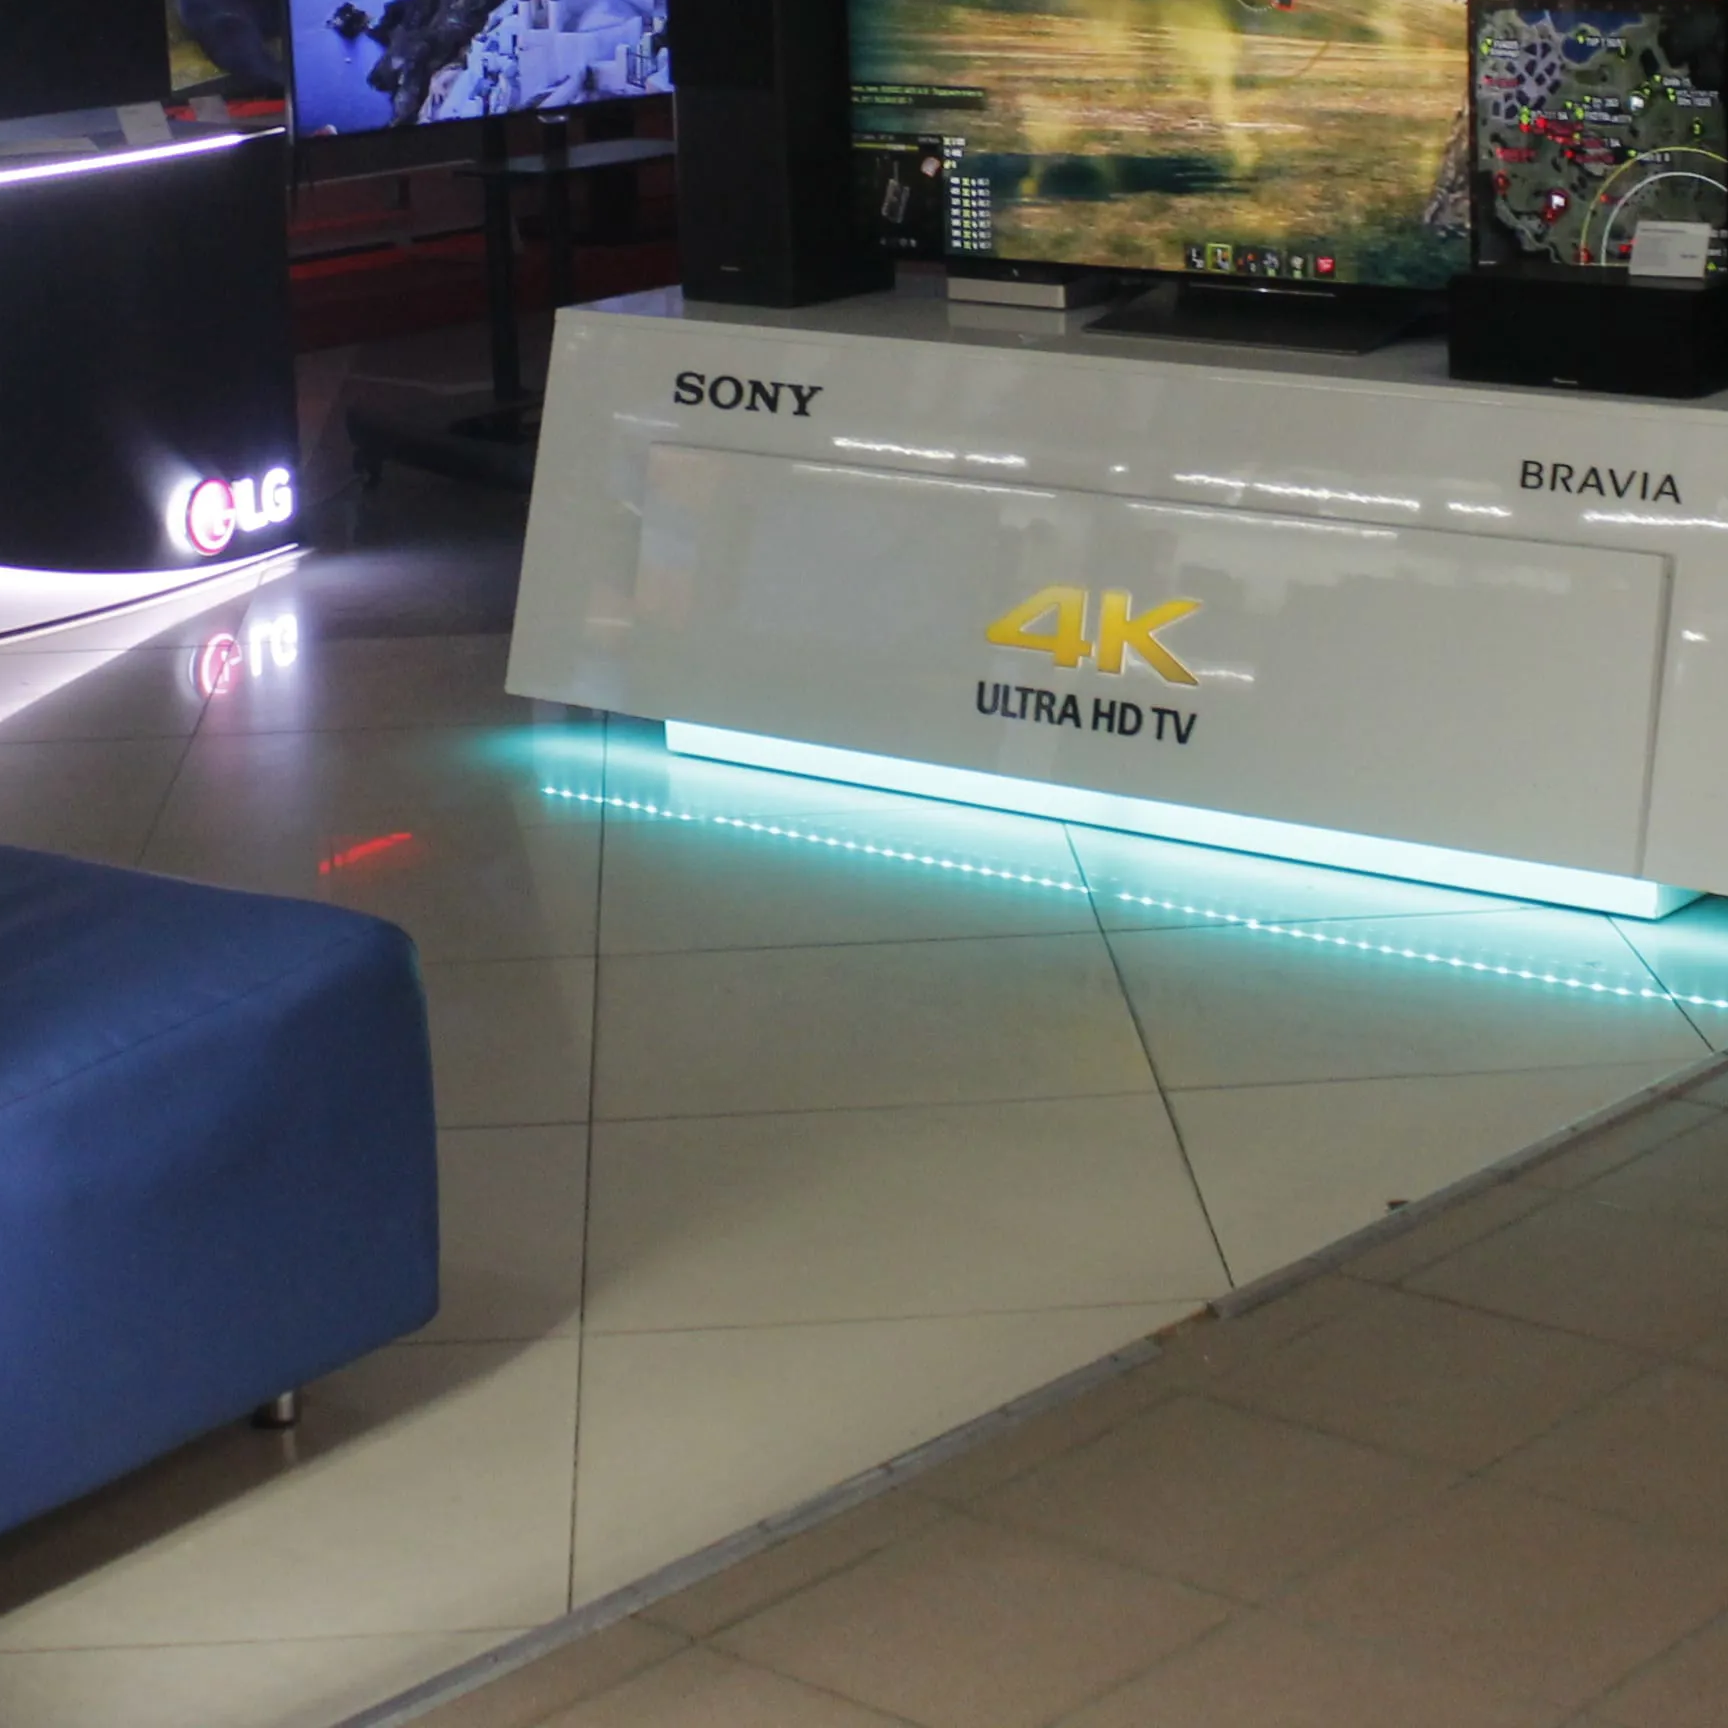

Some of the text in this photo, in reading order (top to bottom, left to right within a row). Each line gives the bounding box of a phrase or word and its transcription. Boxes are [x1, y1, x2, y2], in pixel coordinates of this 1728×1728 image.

[673, 370, 824, 418] SONY
[234, 466, 293, 533] LG
[1519, 459, 1684, 506] BRAVIA
[986, 585, 1204, 687] 4K
[976, 679, 1198, 746] ULTRA HD TV
